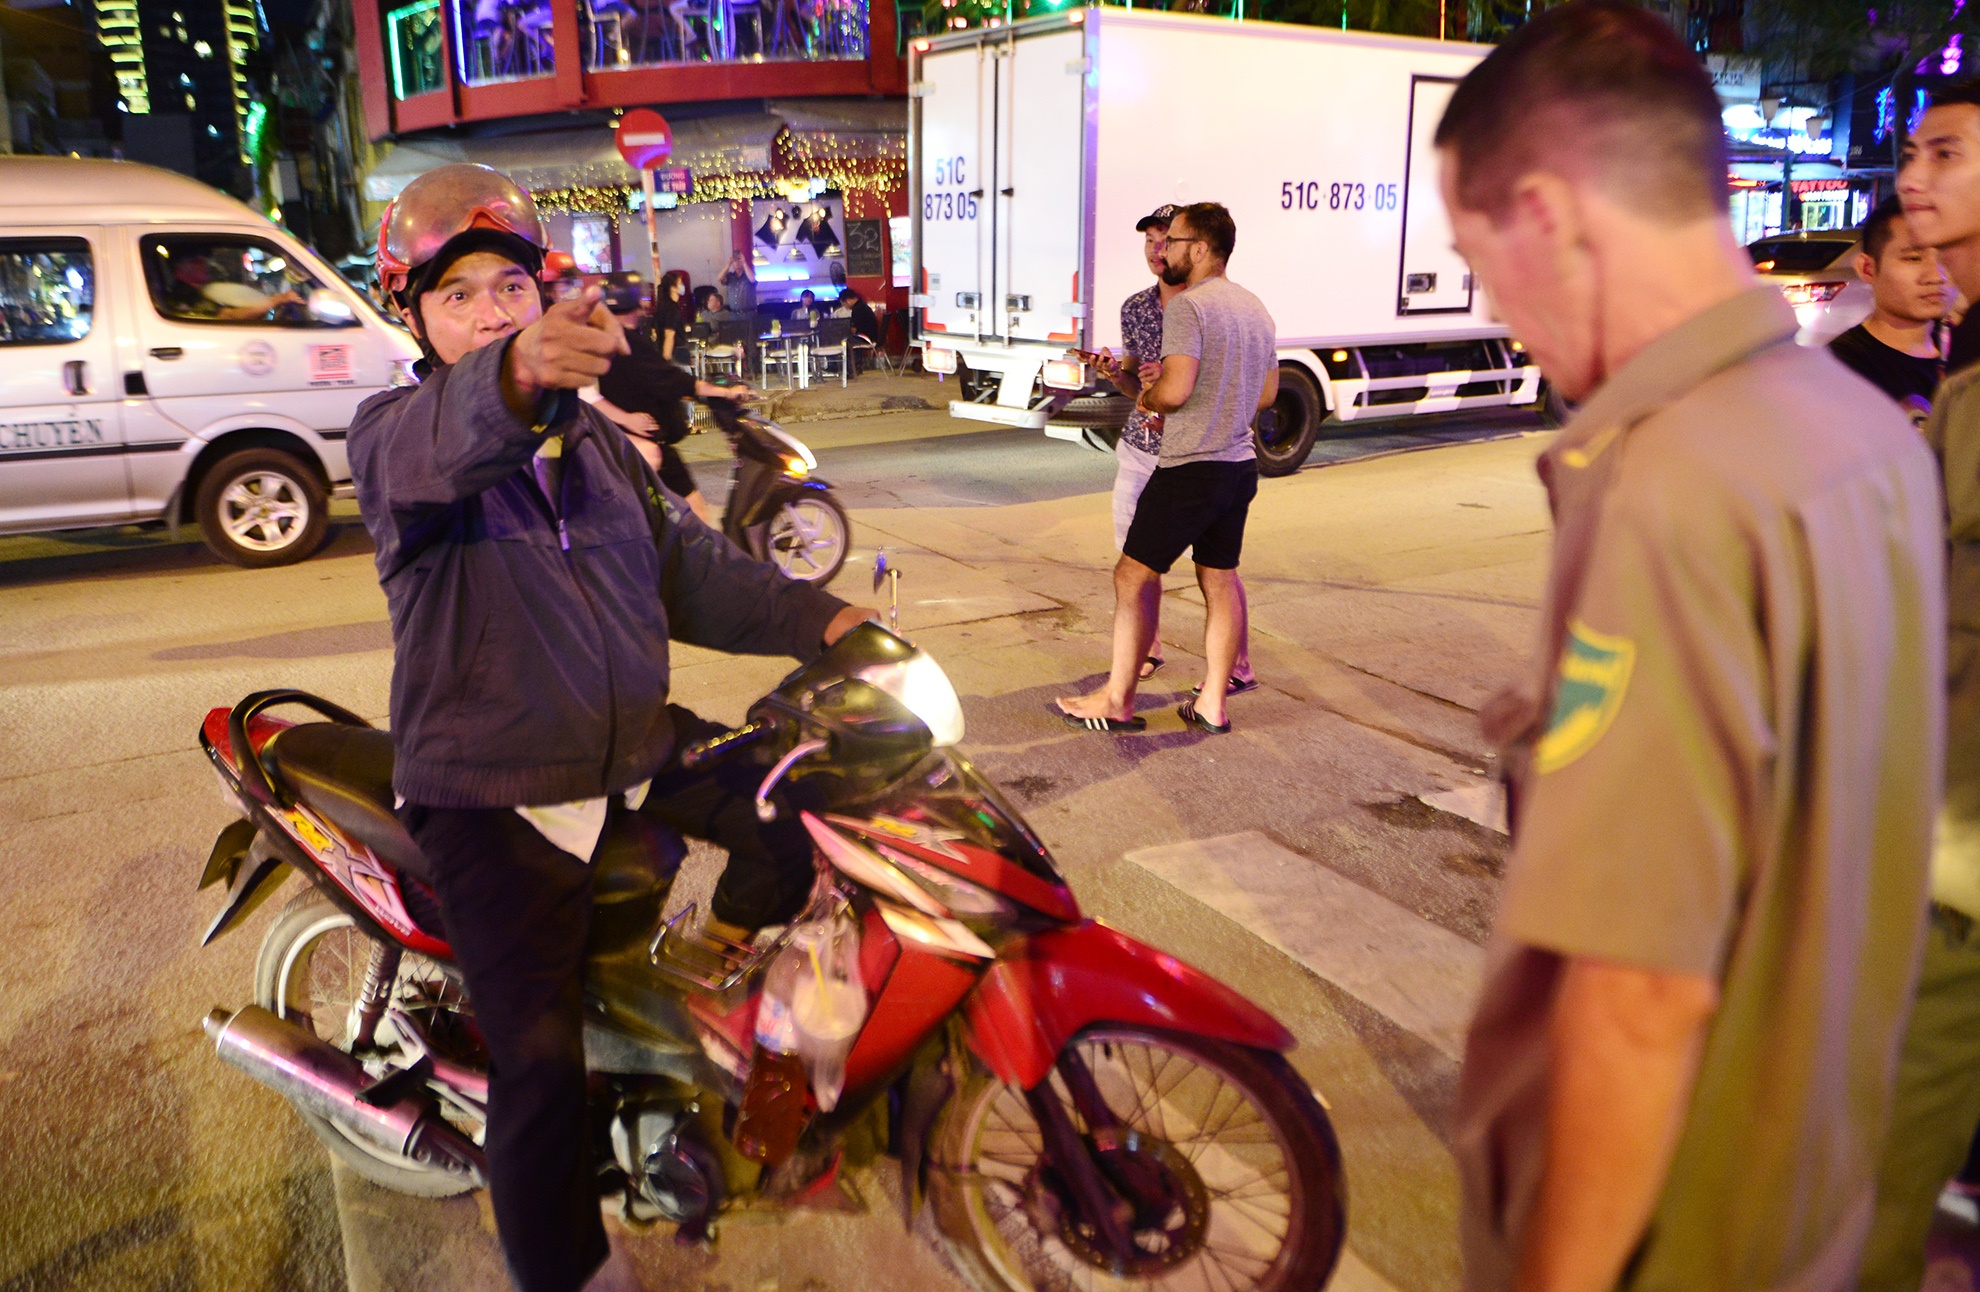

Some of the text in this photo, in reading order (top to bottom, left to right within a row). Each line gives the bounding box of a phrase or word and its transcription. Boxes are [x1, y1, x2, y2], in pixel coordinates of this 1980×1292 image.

[936, 156, 965, 186] 51C
[1281, 181, 1397, 210] 51C 873 05
[1790, 179, 1848, 193] TATTOO
[925, 191, 977, 220] 873 05
